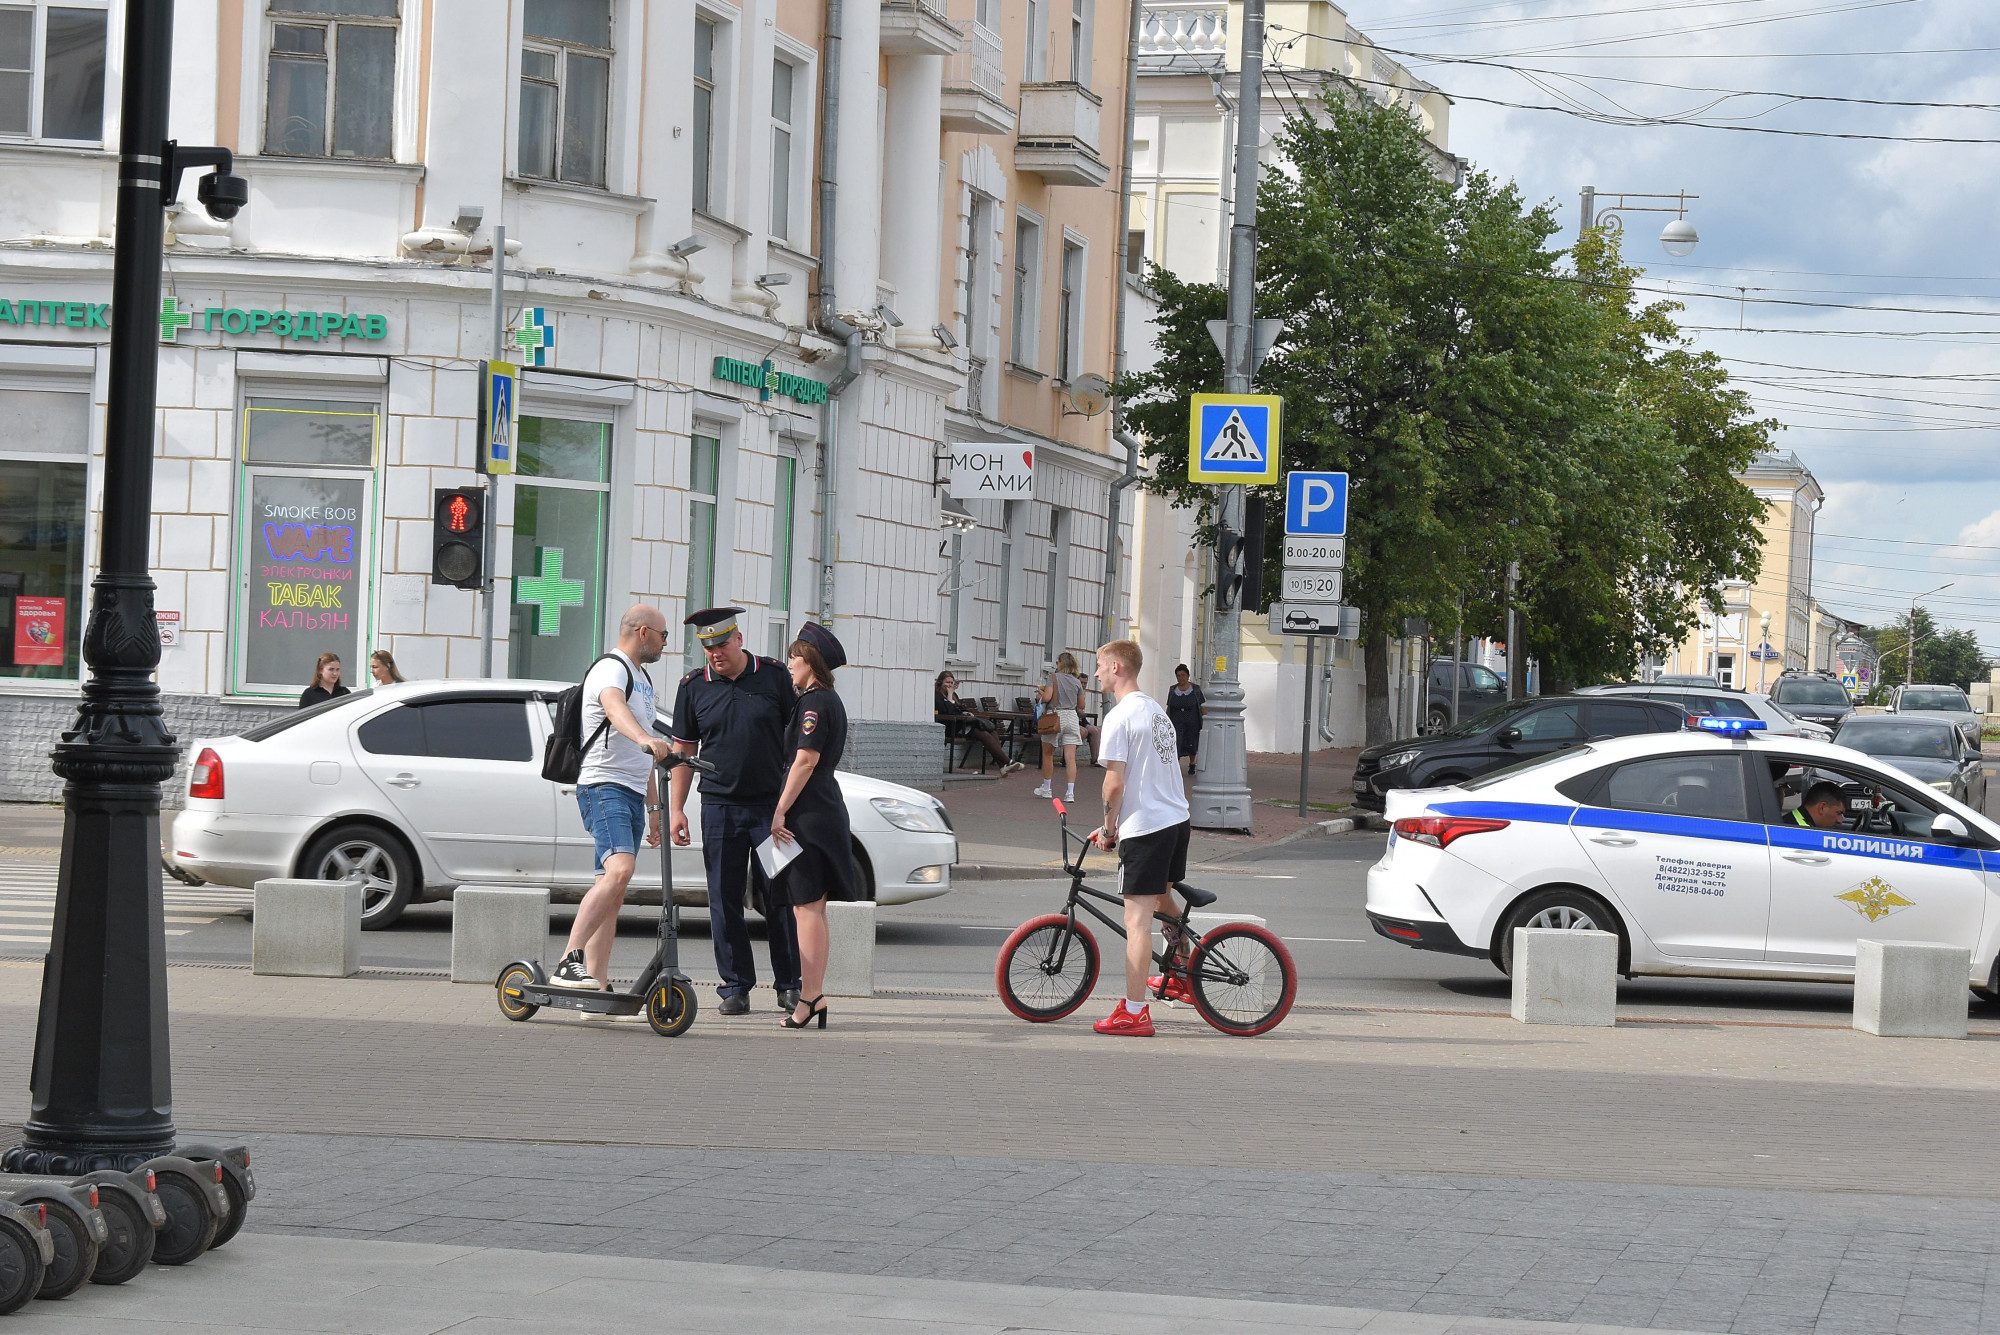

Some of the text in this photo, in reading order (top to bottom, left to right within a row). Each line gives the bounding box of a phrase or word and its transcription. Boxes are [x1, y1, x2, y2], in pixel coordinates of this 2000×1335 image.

[0, 299, 109, 329] АПТЕК
[204, 307, 388, 342] ГОРЗДРАВ
[718, 357, 828, 404] АПТЕКИ ГОРЗДРАВ
[951, 453, 1003, 471] МОН
[979, 474, 1032, 491] АМИ
[1300, 479, 1335, 527] P
[264, 504, 357, 521] SMOKE BOB
[263, 522, 354, 563] VAPE
[1286, 546, 1342, 559] 8.00-20.00
[260, 565, 353, 581] ЭЛЕКТРОНКИ
[1290, 579, 1333, 592] 10 15 20
[267, 581, 342, 608] ТАБАК
[260, 608, 349, 631] КАЛЬЯН
[1823, 835, 1923, 858] ПОЛИЦИЯ
[1656, 855, 1732, 870] Телефон доверия
[1659, 864, 1726, 879] 8(4822)32-95-52
[1655, 873, 1727, 888] Дежурная часть
[1657, 882, 1724, 897] 8(4822)58-04-00
